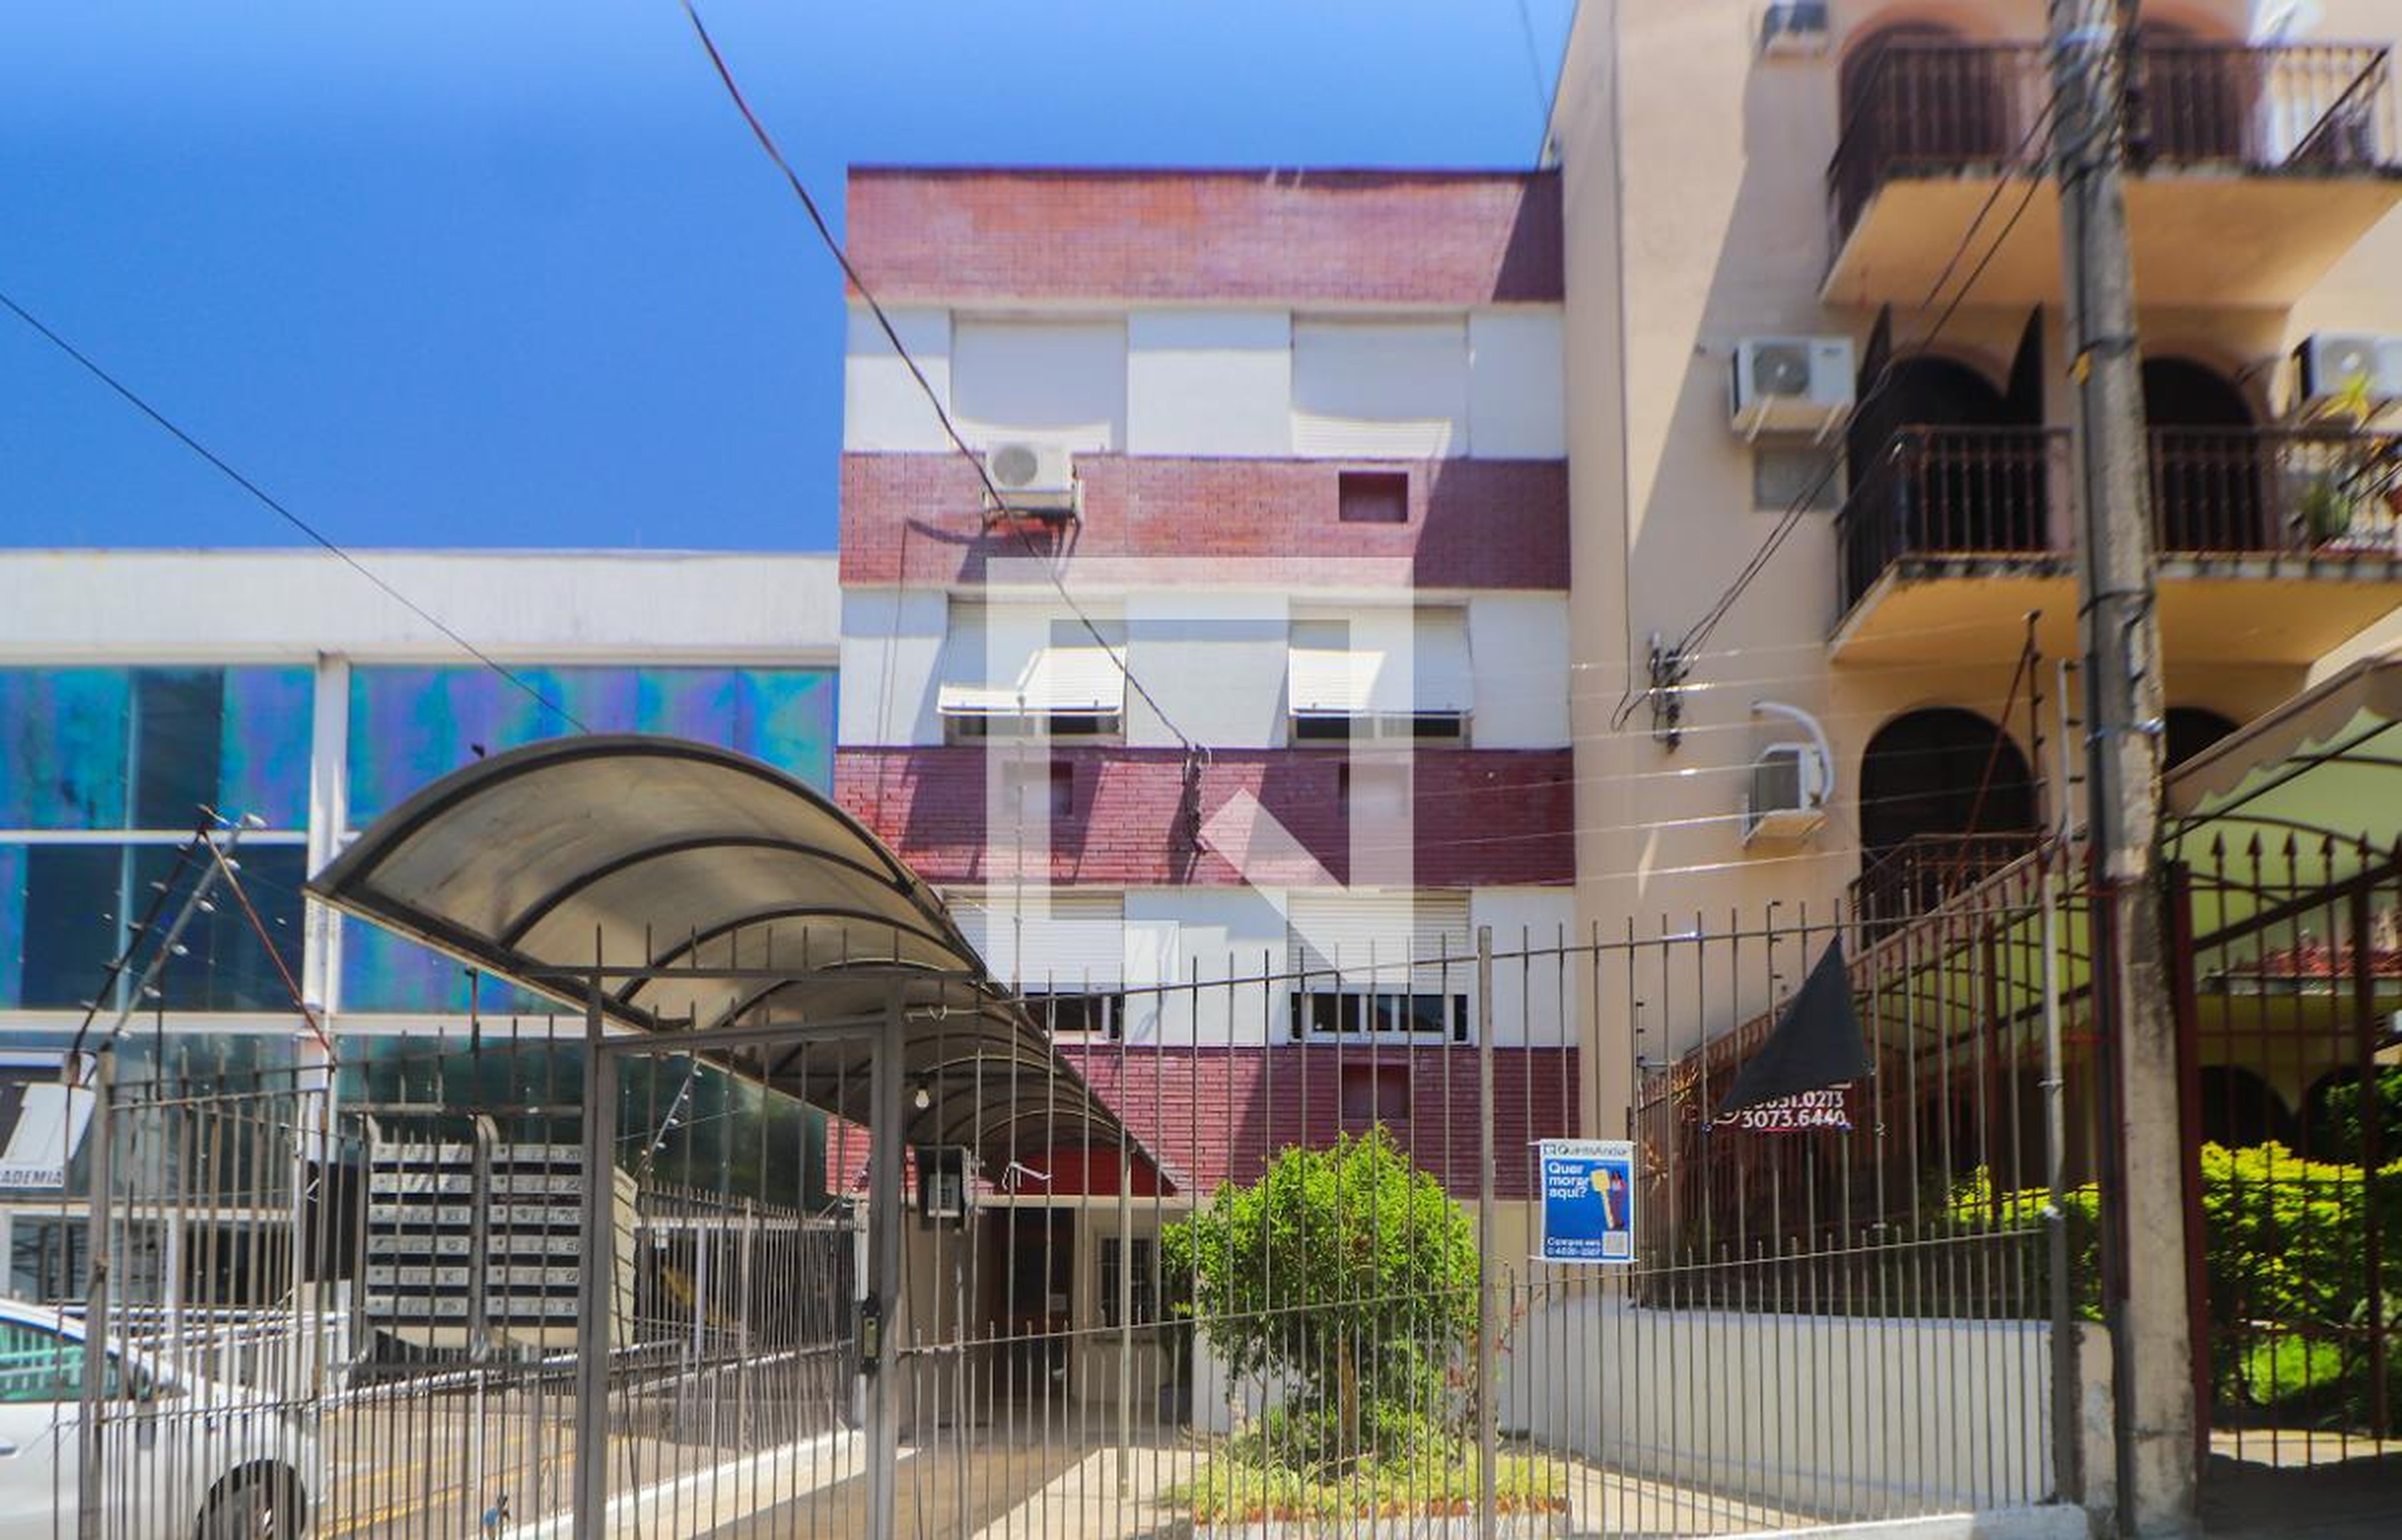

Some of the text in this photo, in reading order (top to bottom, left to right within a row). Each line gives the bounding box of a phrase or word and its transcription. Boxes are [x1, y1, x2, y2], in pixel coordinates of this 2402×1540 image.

[1742, 1108, 1846, 1128] 3073.6440
[1548, 1162, 1584, 1175] Quer
[0, 1170, 62, 1185] ADEMIA
[1549, 1176, 1589, 1187] morar
[1549, 1187, 1588, 1200] aqui?
